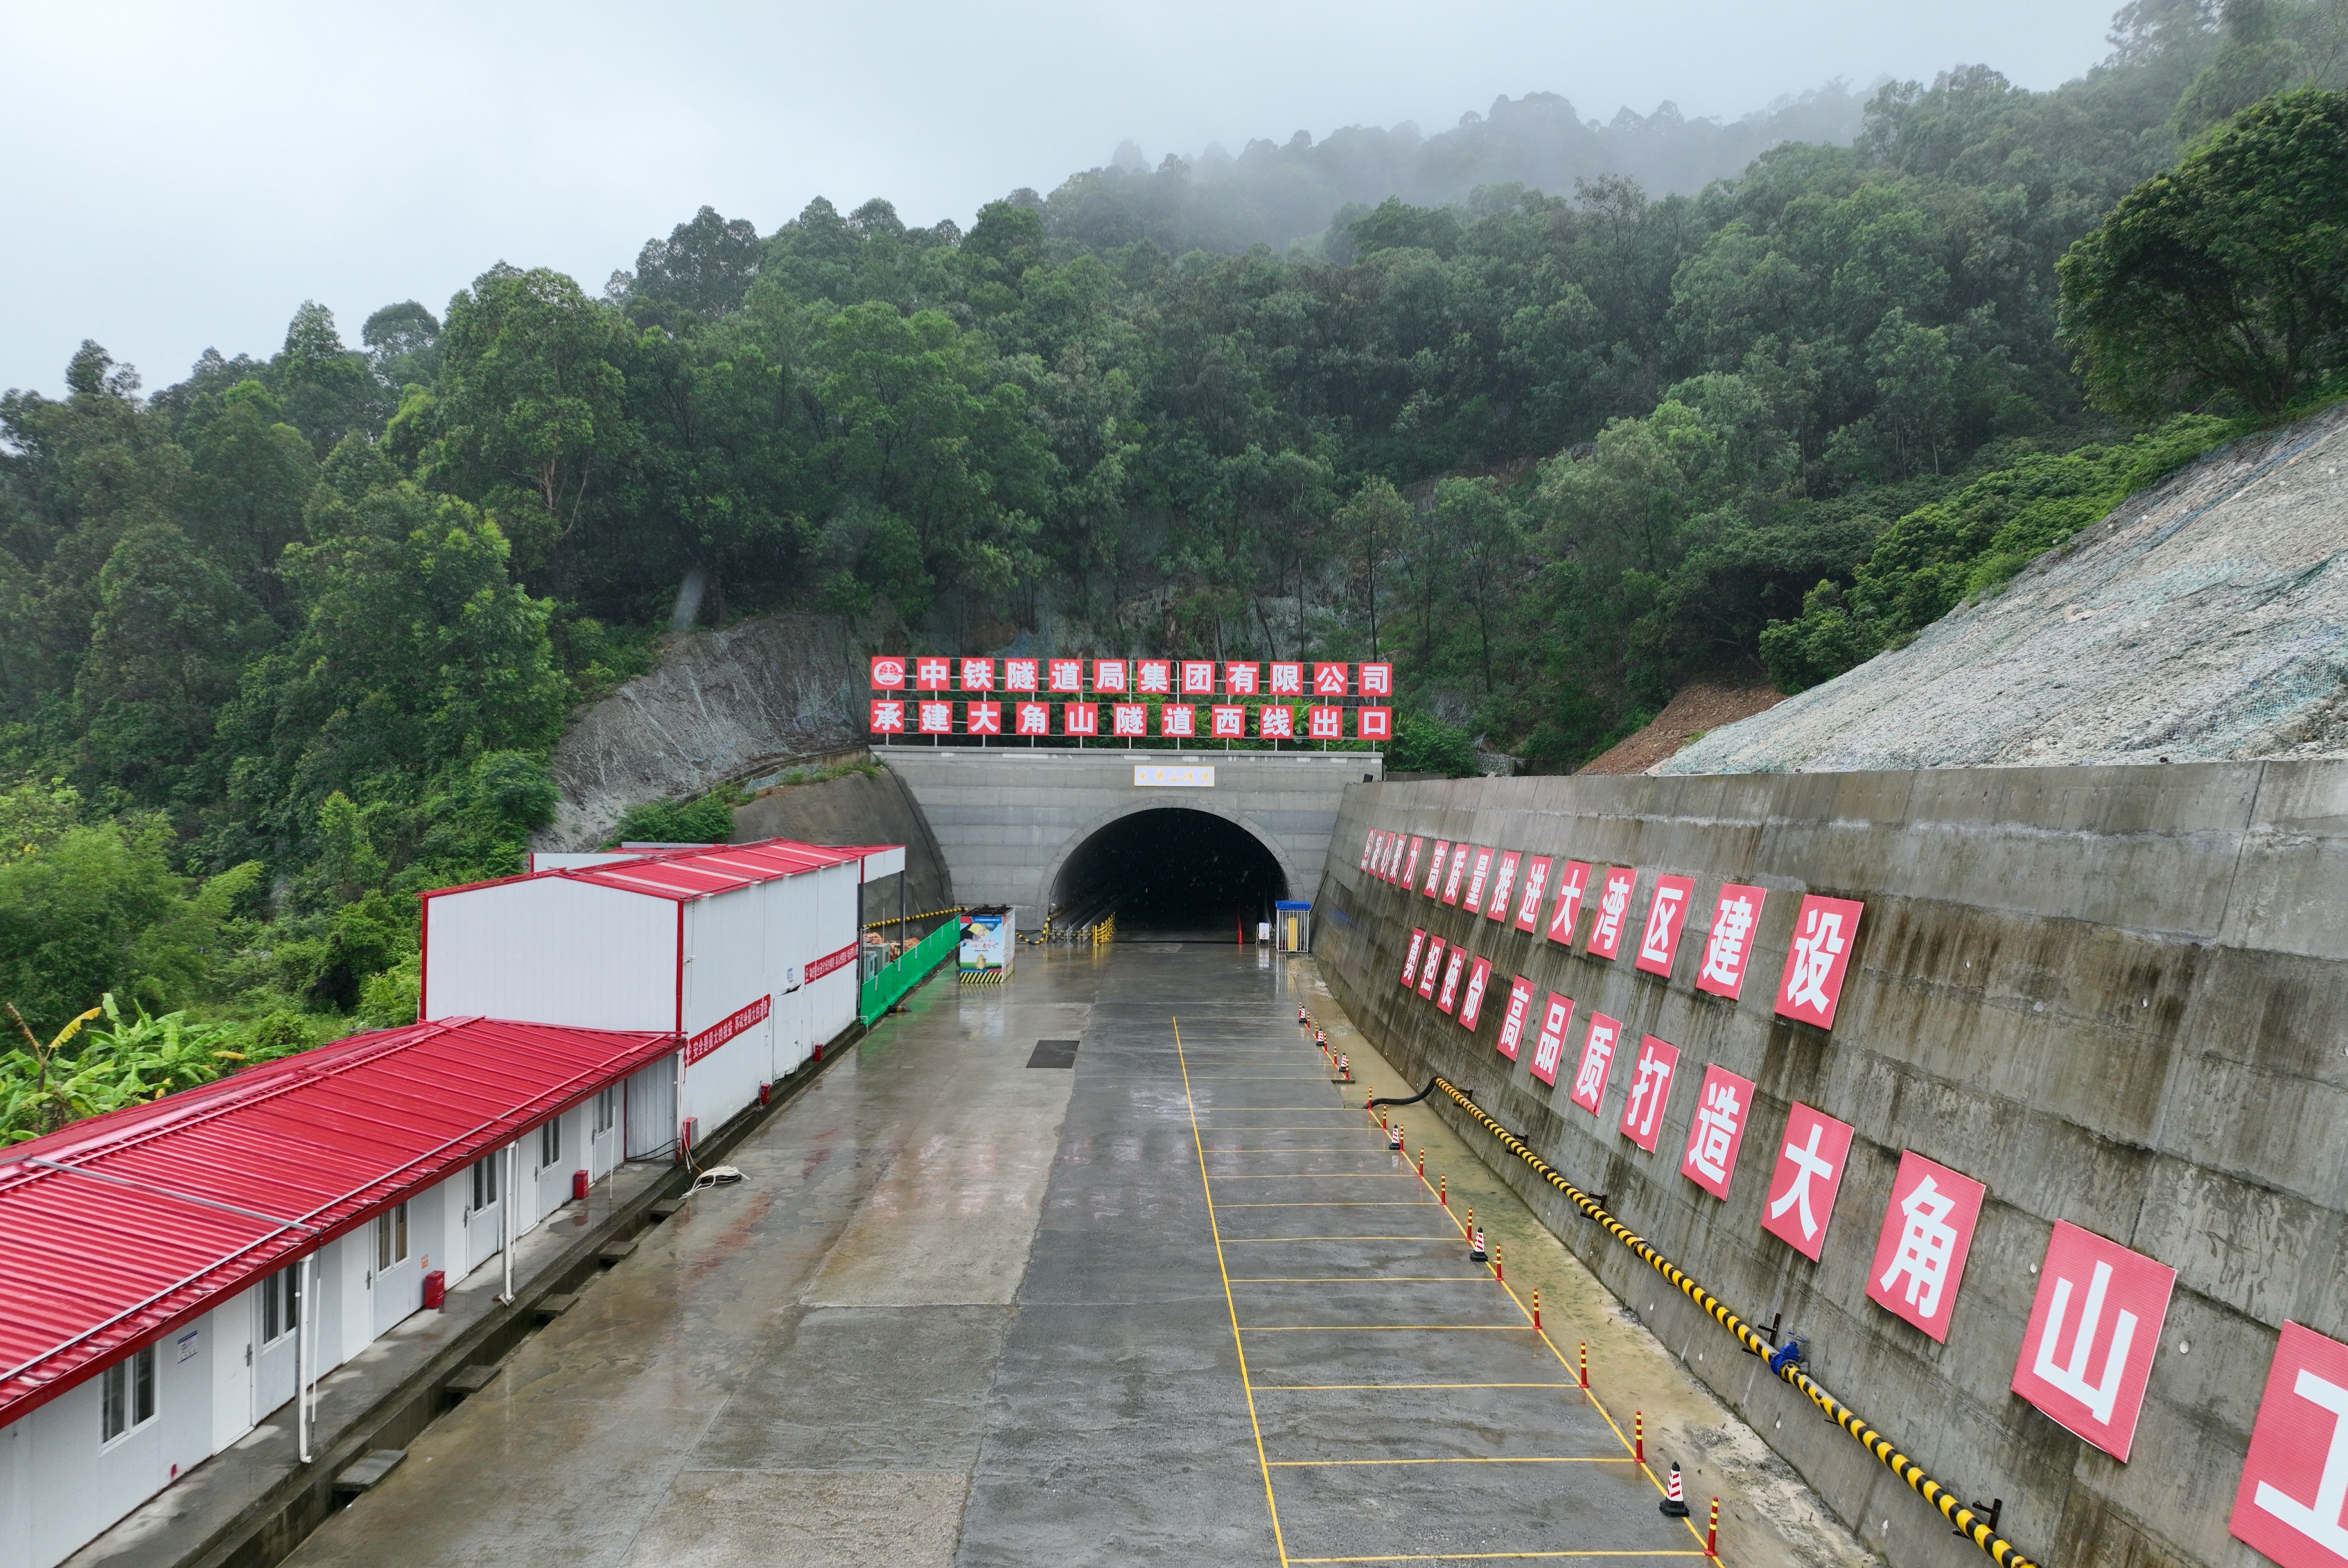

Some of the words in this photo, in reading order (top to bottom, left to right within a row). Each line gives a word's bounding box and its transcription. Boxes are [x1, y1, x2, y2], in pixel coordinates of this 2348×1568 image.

[920, 659, 1388, 694] 中铁隧道局集团有限公司
[873, 703, 1386, 737] 承建大角山隧道西线出口
[1137, 769, 1212, 783] 大角山隧道
[1371, 834, 1418, 883] 凝心聚力
[1426, 845, 1845, 1015] 高质量推进大湾区建设
[1403, 934, 1483, 1022] 勇担使命
